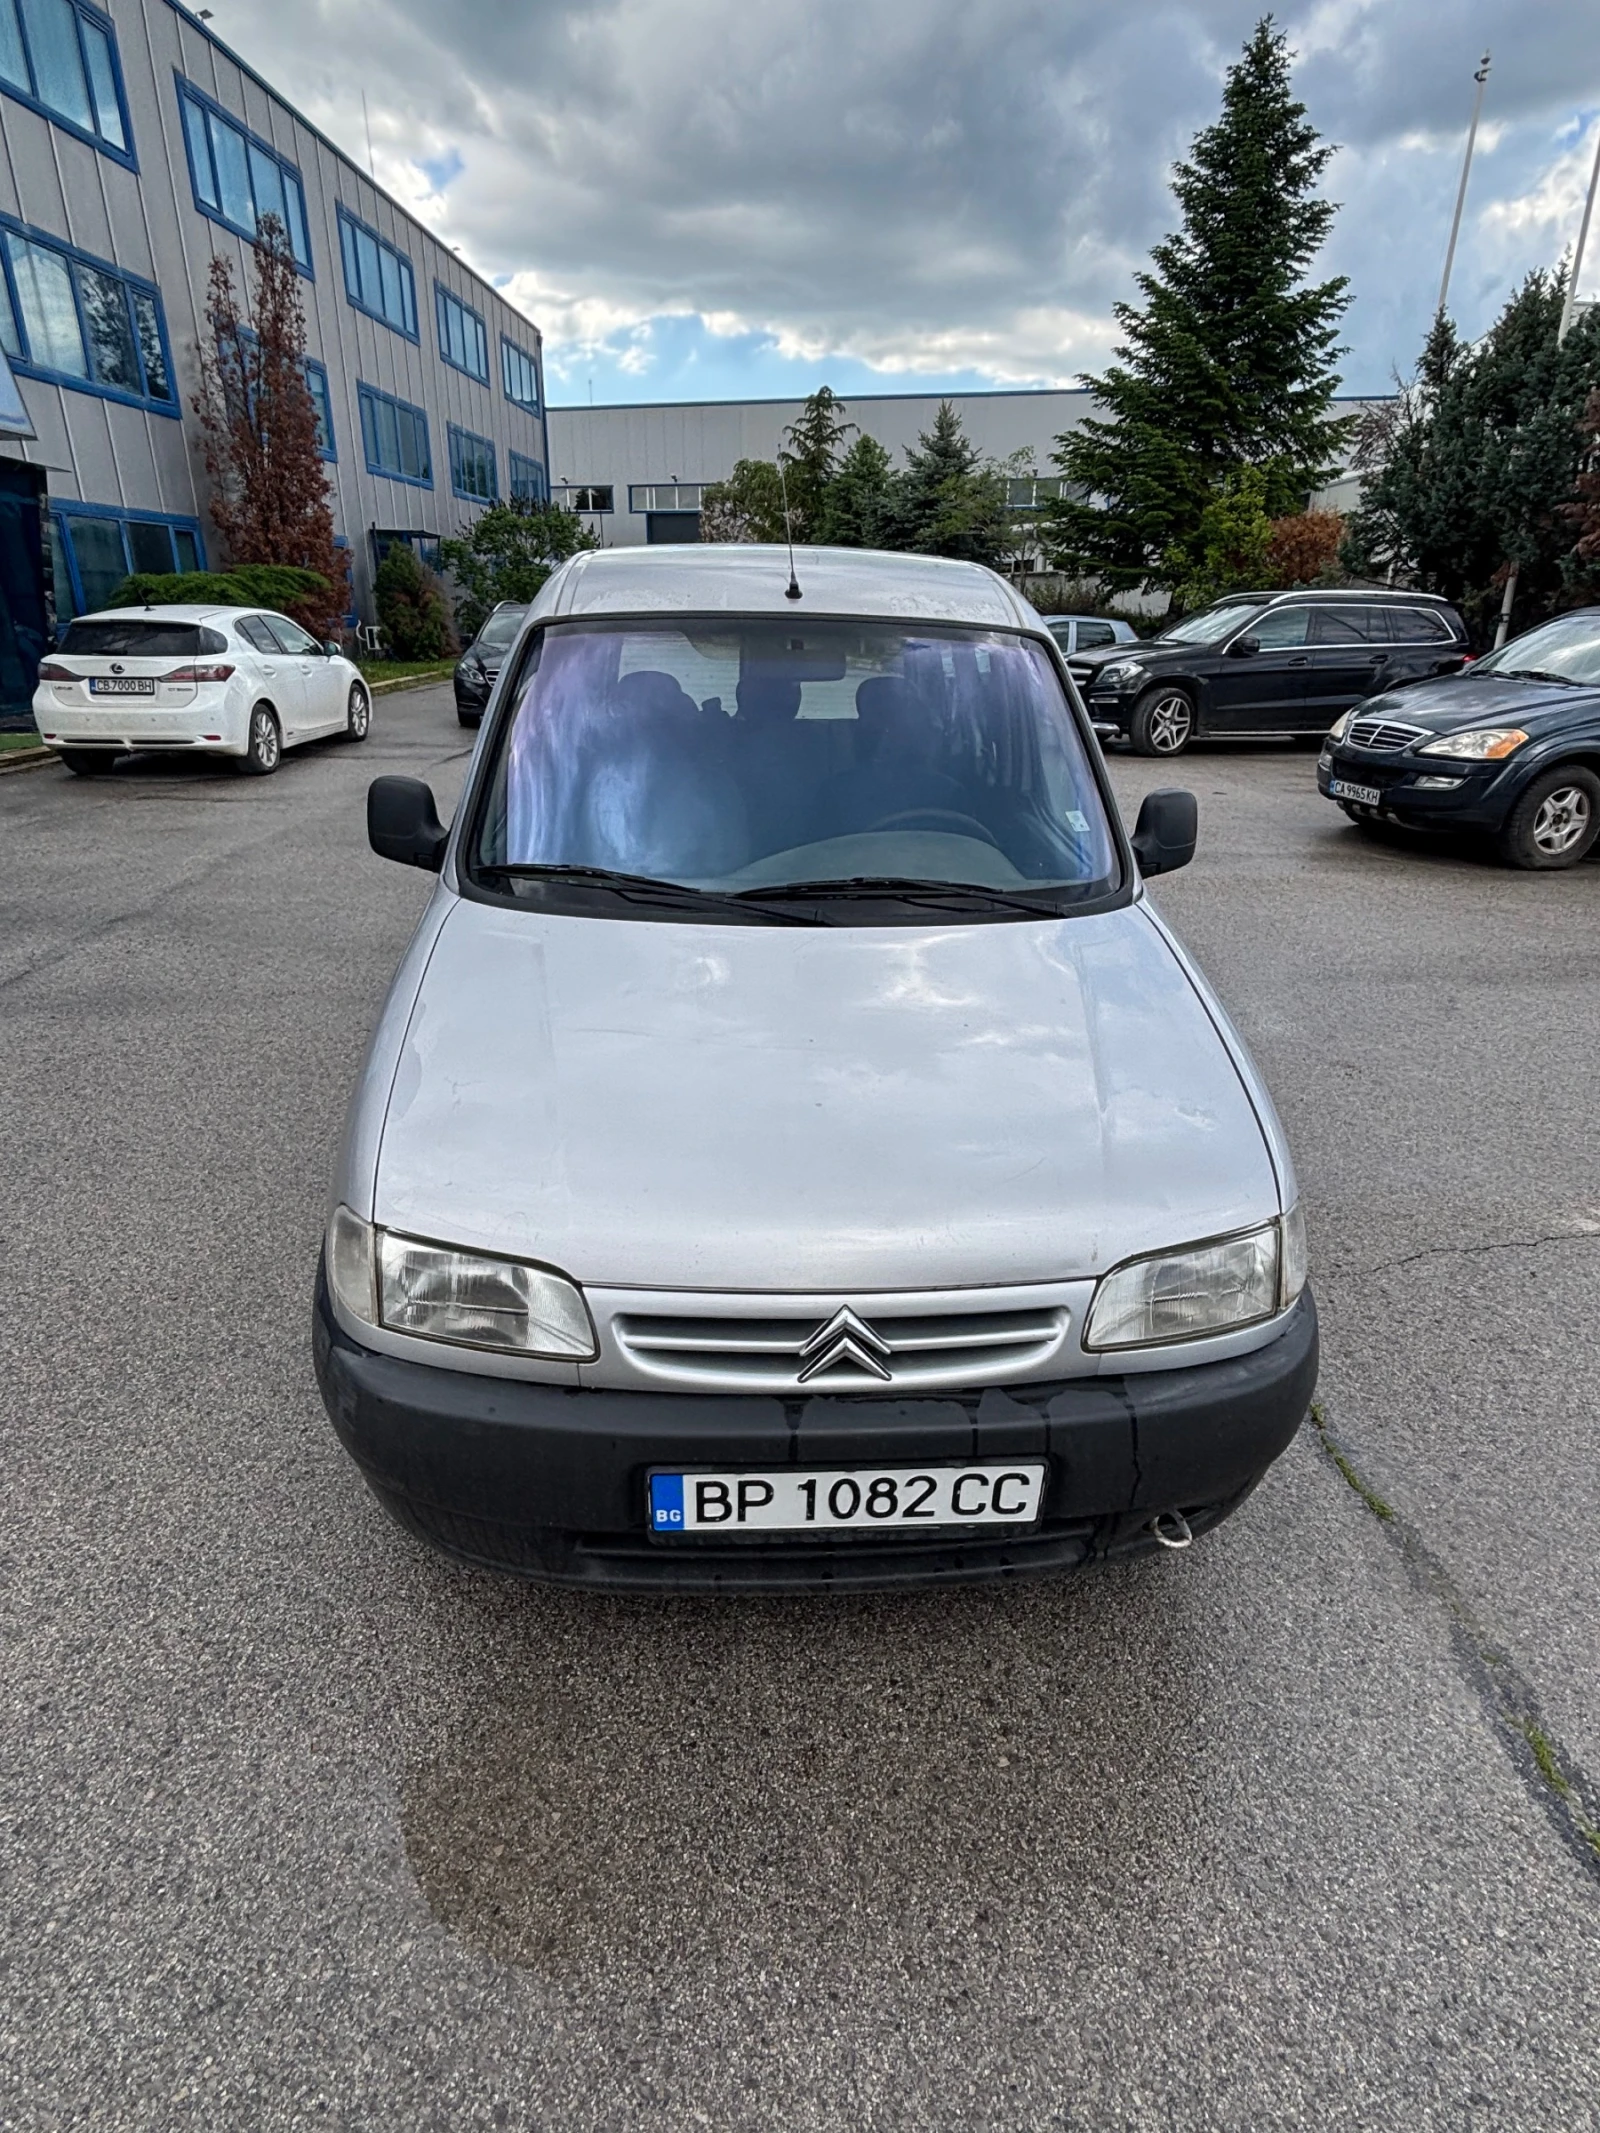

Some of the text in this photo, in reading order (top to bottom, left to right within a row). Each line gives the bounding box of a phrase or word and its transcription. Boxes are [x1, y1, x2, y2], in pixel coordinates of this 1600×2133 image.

[111, 680, 136, 691] 7000
[138, 680, 151, 691] BH
[1335, 782, 1379, 804] CA 9965 KH
[696, 1472, 1030, 1523] BP 1082 CC
[655, 1509, 681, 1522] BG
